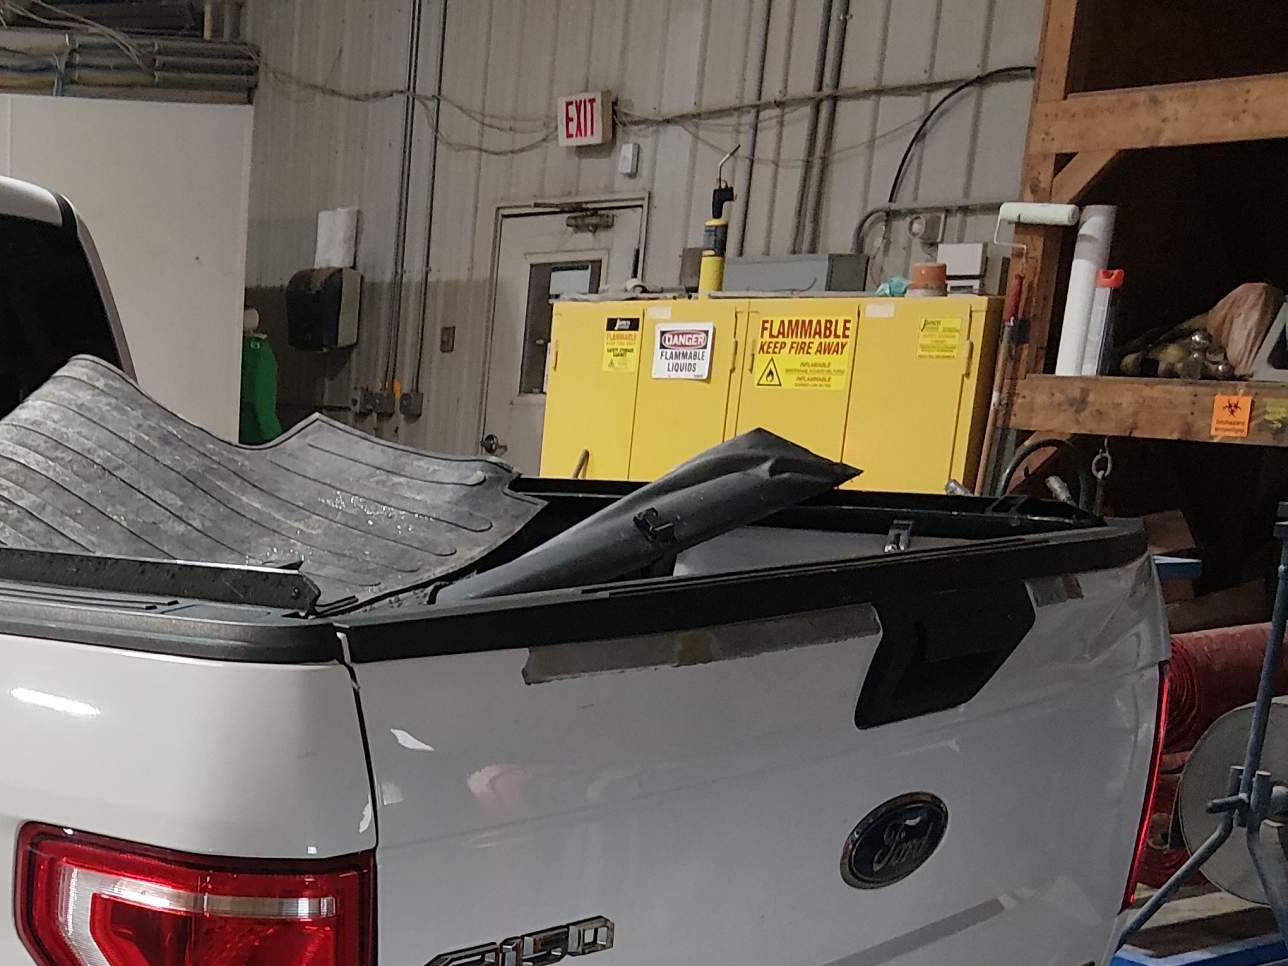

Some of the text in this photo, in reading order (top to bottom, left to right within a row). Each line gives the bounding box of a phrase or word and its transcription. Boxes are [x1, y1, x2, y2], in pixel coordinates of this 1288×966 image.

[565, 98, 596, 139] EXIT
[760, 319, 852, 339] FLAMMABLE
[665, 334, 705, 346] DANGER
[758, 341, 848, 355] KEEP FIRE AWAY
[660, 350, 705, 361] FLAMMABLE
[667, 362, 697, 373] LIQUIDS
